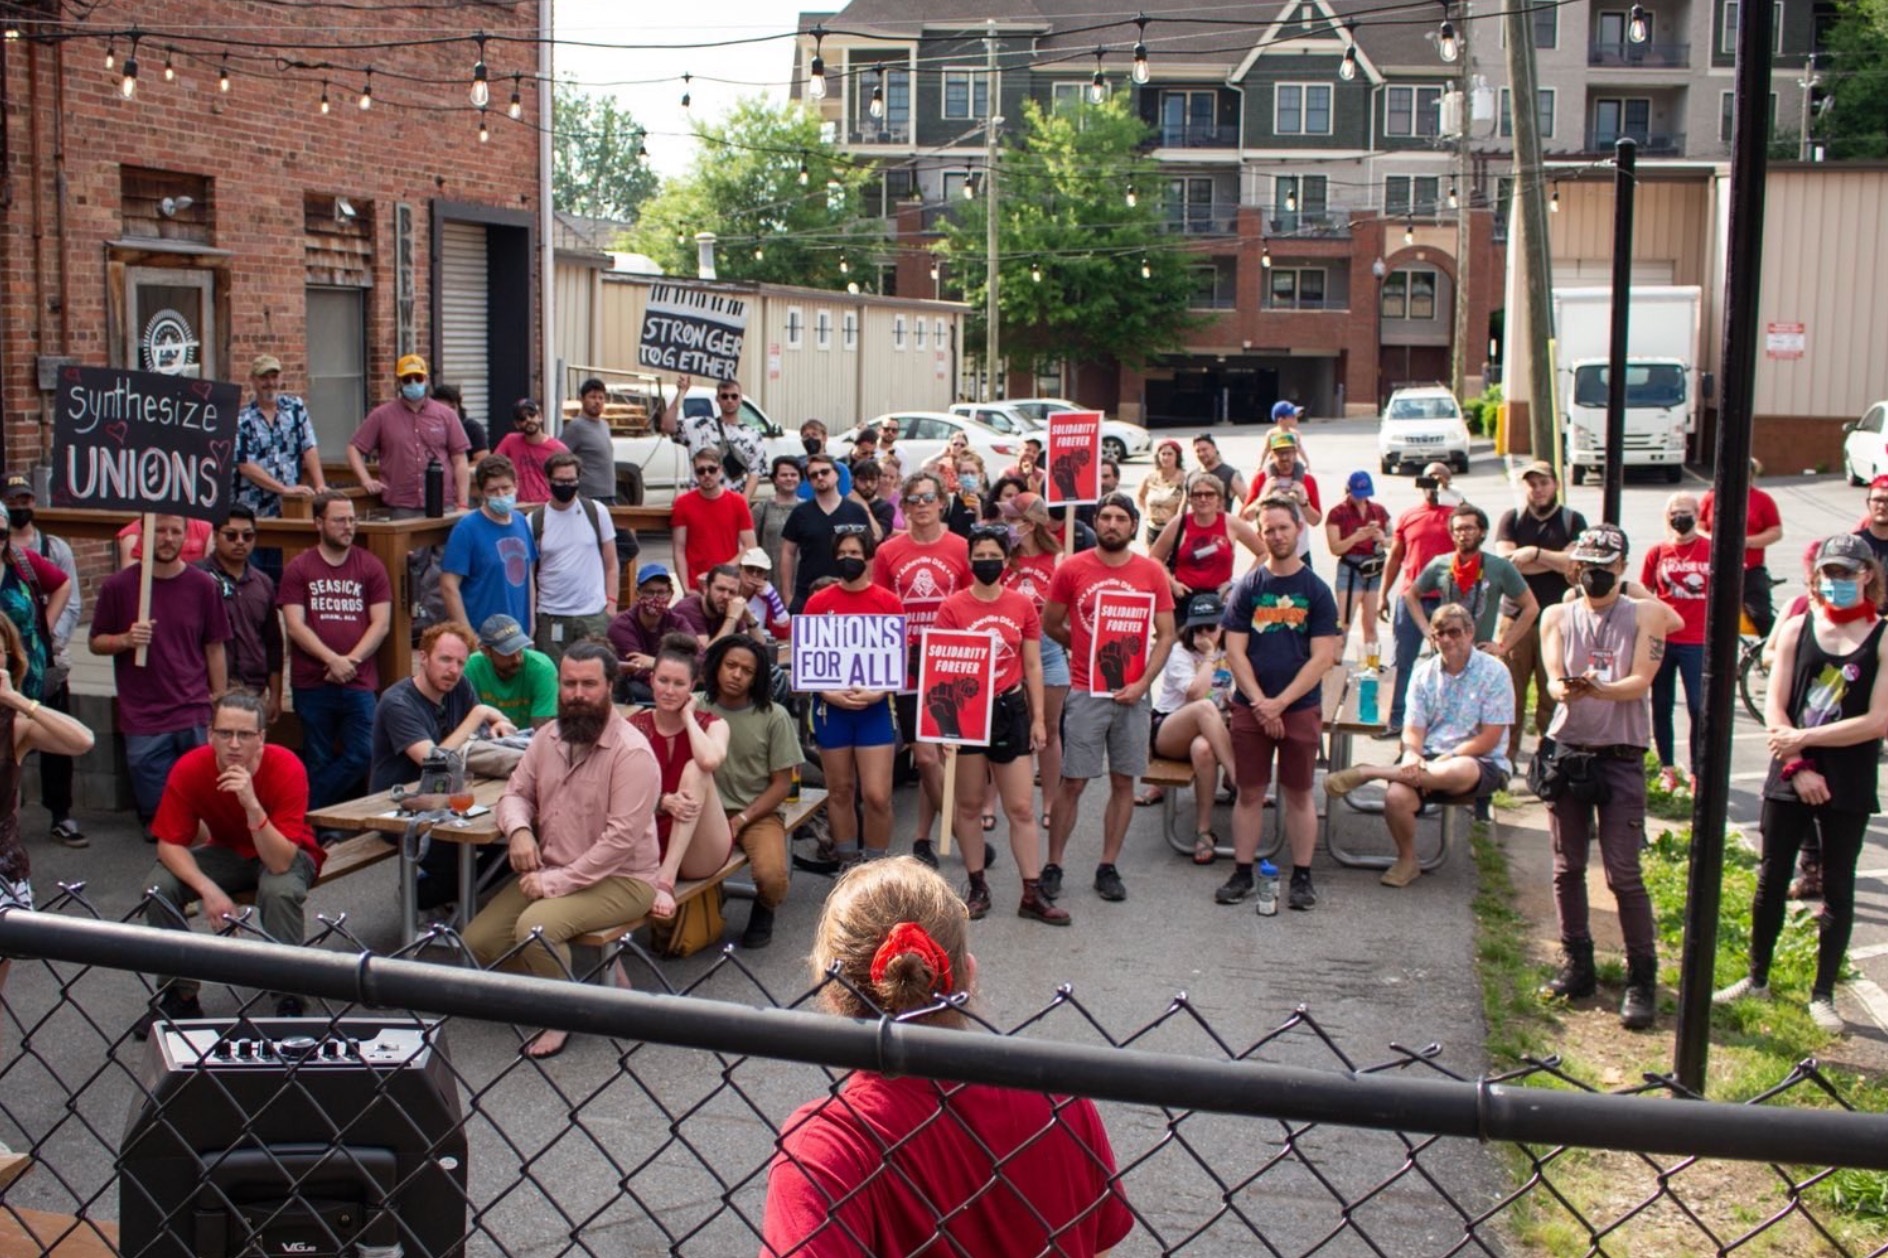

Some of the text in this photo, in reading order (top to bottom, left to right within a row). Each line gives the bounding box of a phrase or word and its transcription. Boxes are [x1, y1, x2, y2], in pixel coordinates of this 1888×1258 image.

[399, 206, 414, 356] BREWE
[643, 317, 743, 358] STRONGER
[640, 343, 737, 380] TOGETHER
[1051, 423, 1097, 435] SOLIDARITY
[1056, 435, 1091, 448] FOREVER
[66, 444, 220, 509] UNIONS
[308, 578, 363, 597] SEASICK
[310, 597, 364, 612] RECORDS
[1100, 604, 1150, 620] SOLIDARITY
[799, 616, 901, 648] UNIONS
[1105, 619, 1143, 633] FOREVER
[928, 644, 989, 660] SOLIDARITY
[801, 651, 899, 686] FOR ALL
[934, 659, 981, 674] FOREVER
